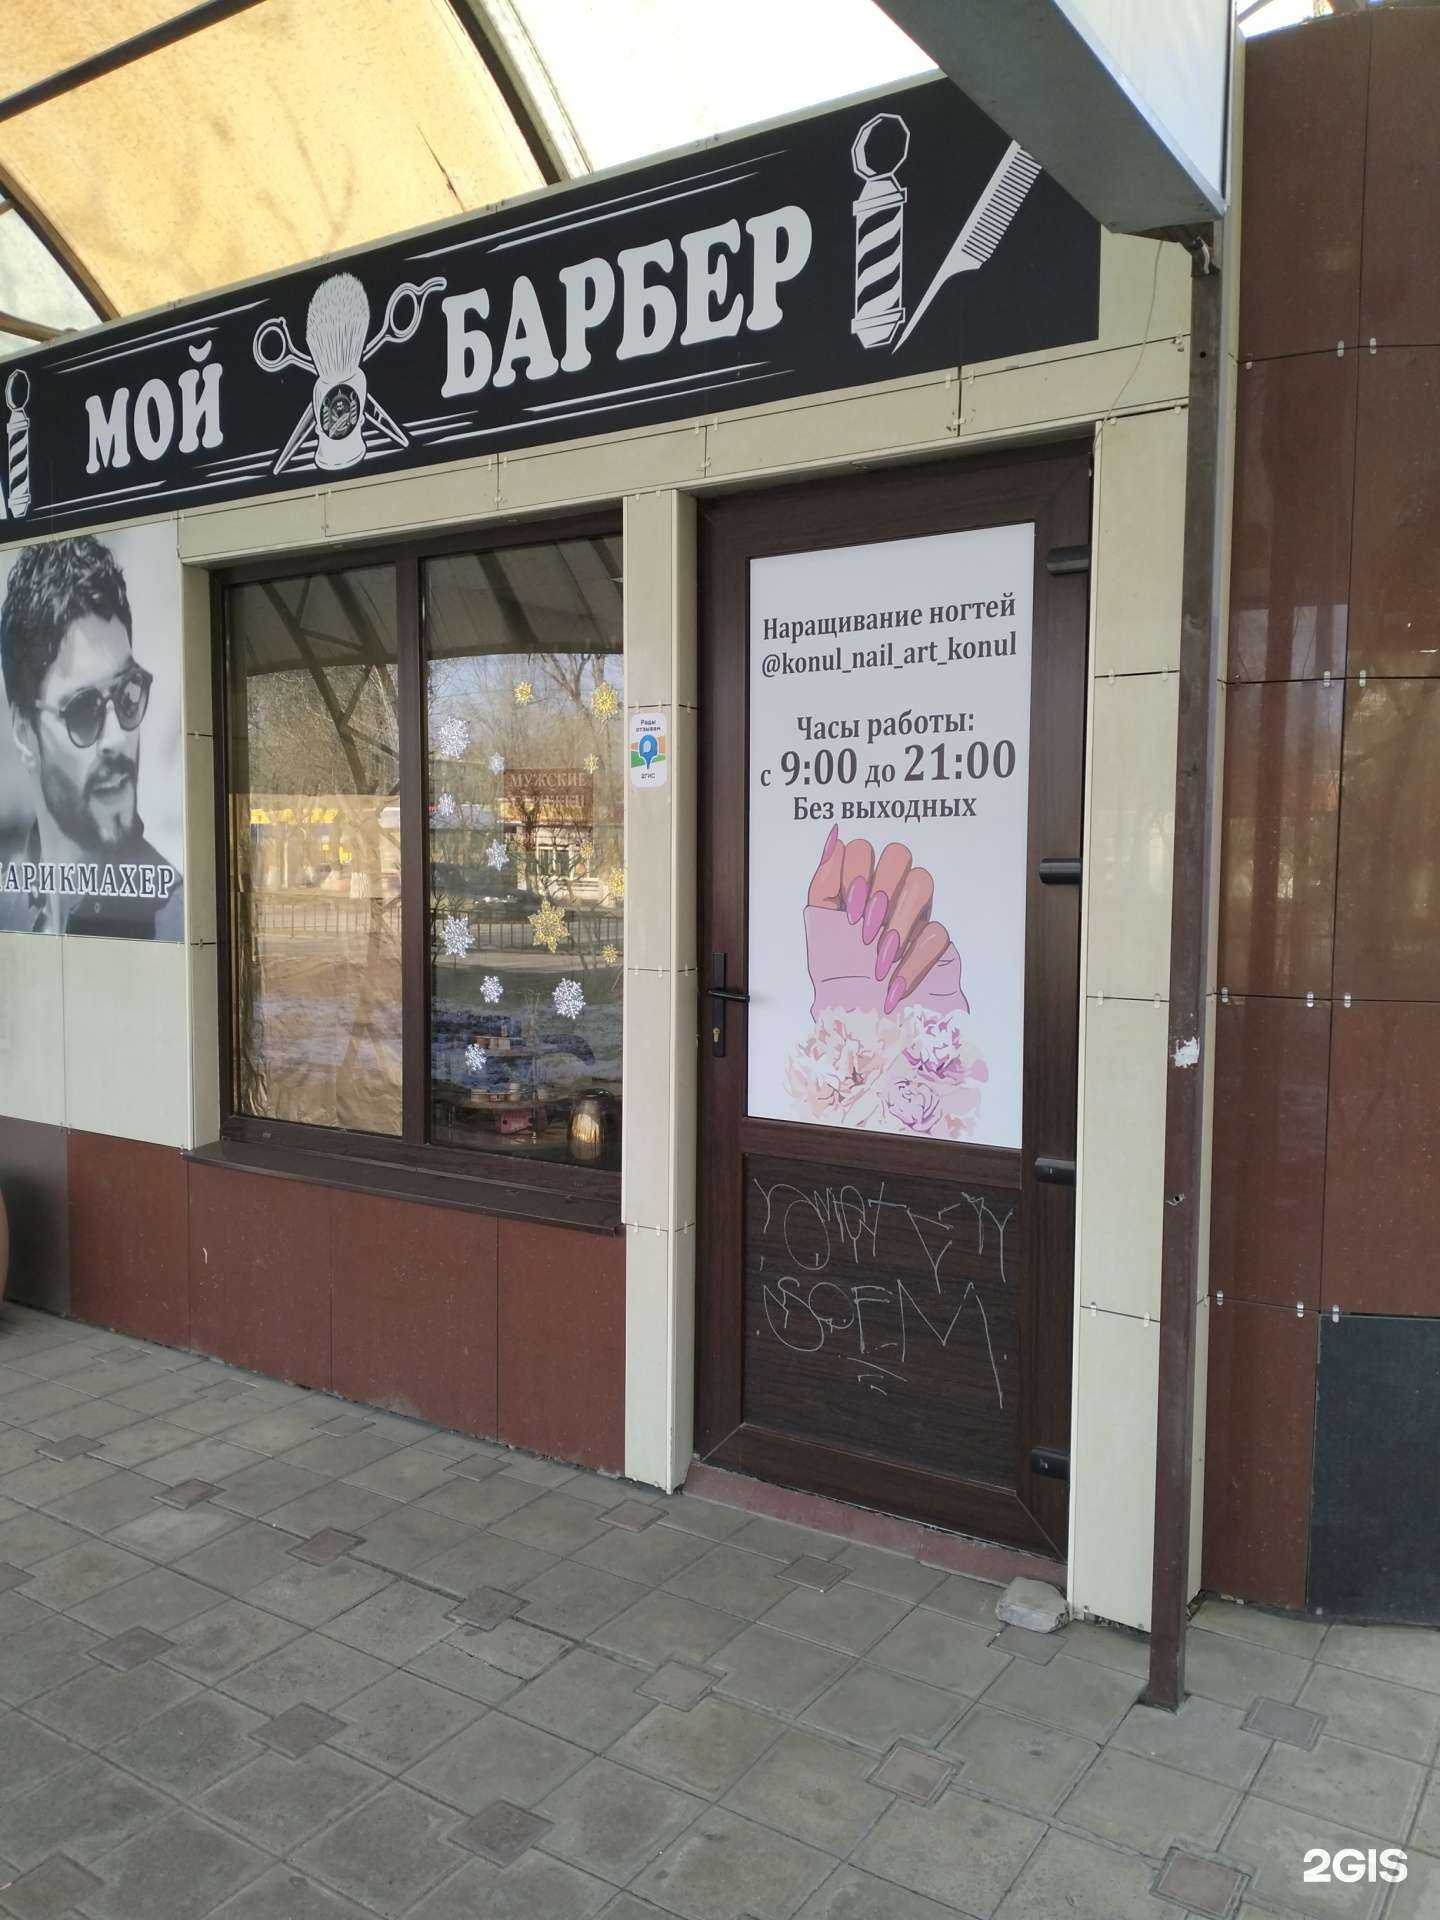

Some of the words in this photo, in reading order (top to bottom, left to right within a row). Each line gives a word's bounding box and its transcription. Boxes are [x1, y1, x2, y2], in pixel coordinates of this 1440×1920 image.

[85, 339, 225, 474] МОЙ
[440, 205, 813, 399] БАРБЕР
[763, 607, 923, 643] Наращивание
[930, 593, 1016, 625] ногтей
[761, 631, 1017, 678] @konul_nail_art_konul
[796, 716, 860, 741] Часы
[867, 709, 975, 744] работы:
[511, 772, 587, 787] МУЖСКИЕ
[760, 768, 772, 787] с
[780, 748, 858, 787] 9:00
[864, 763, 896, 788] до
[903, 740, 1016, 782] 21:00
[793, 796, 834, 821] Без
[841, 798, 978, 823] выходных
[0, 862, 175, 898] АРИКМАХЕР
